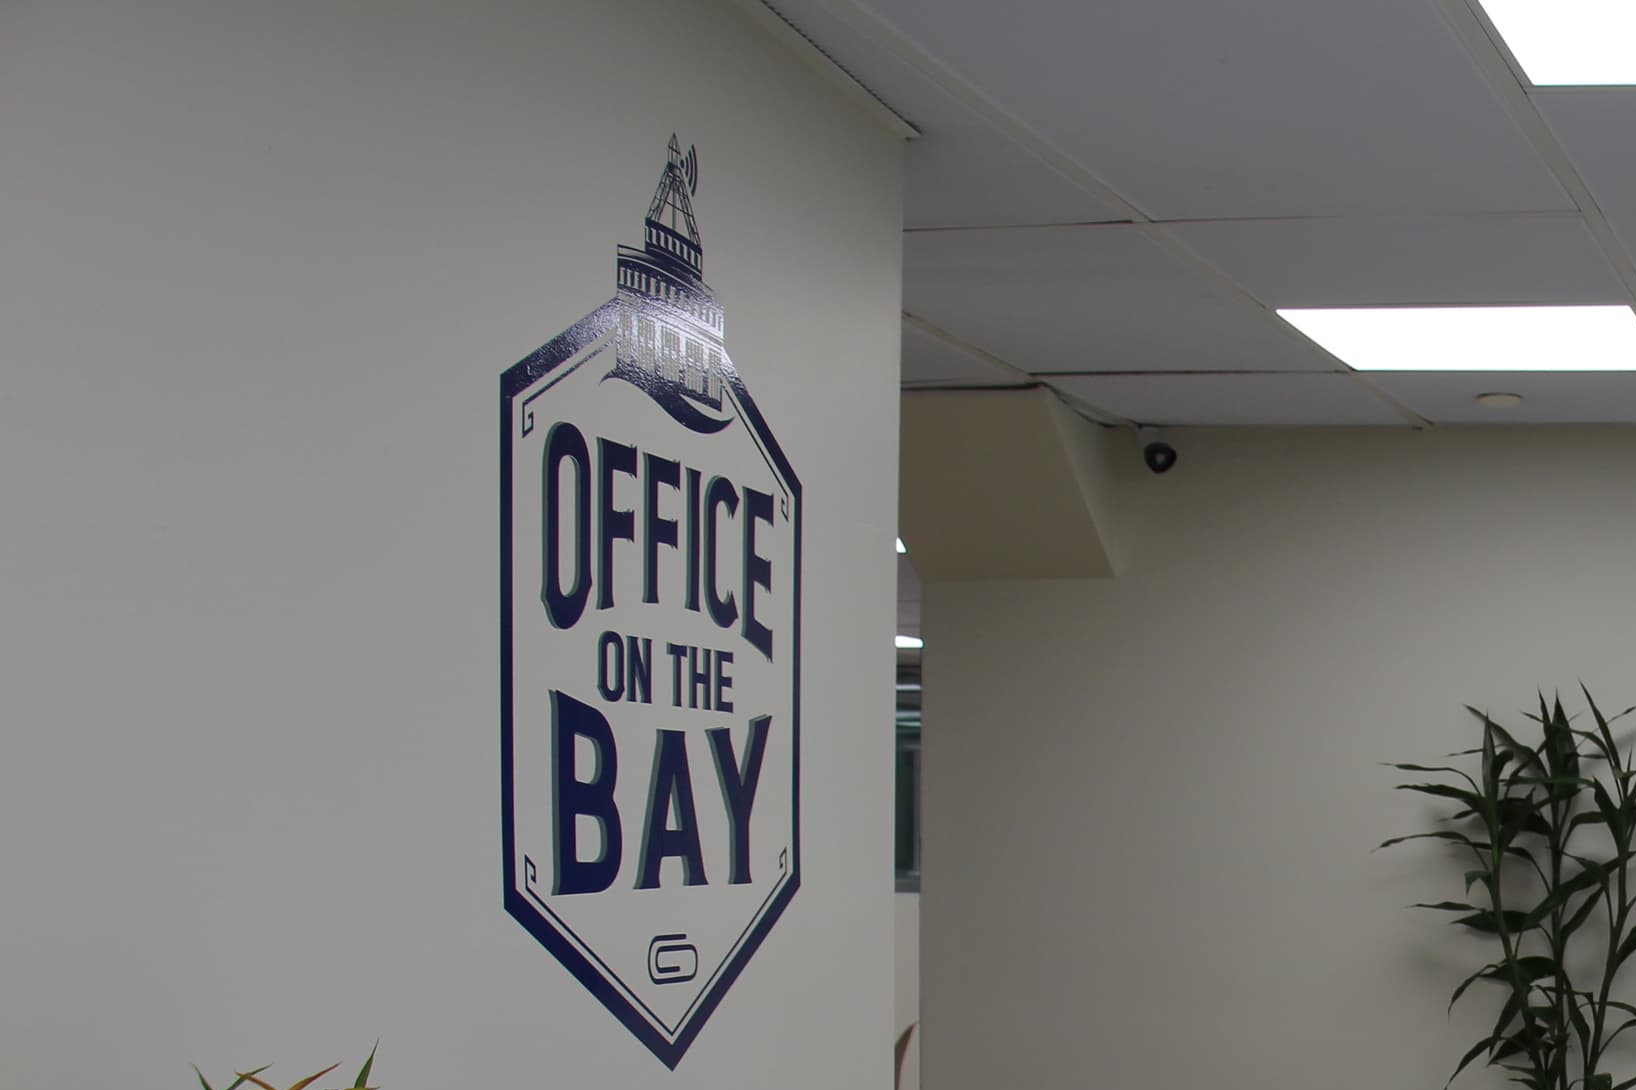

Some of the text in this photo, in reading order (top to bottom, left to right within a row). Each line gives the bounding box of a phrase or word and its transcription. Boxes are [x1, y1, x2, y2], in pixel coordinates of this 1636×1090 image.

[541, 421, 775, 664] OFFICE
[597, 630, 734, 714] ON THE
[548, 689, 773, 897] BAY
